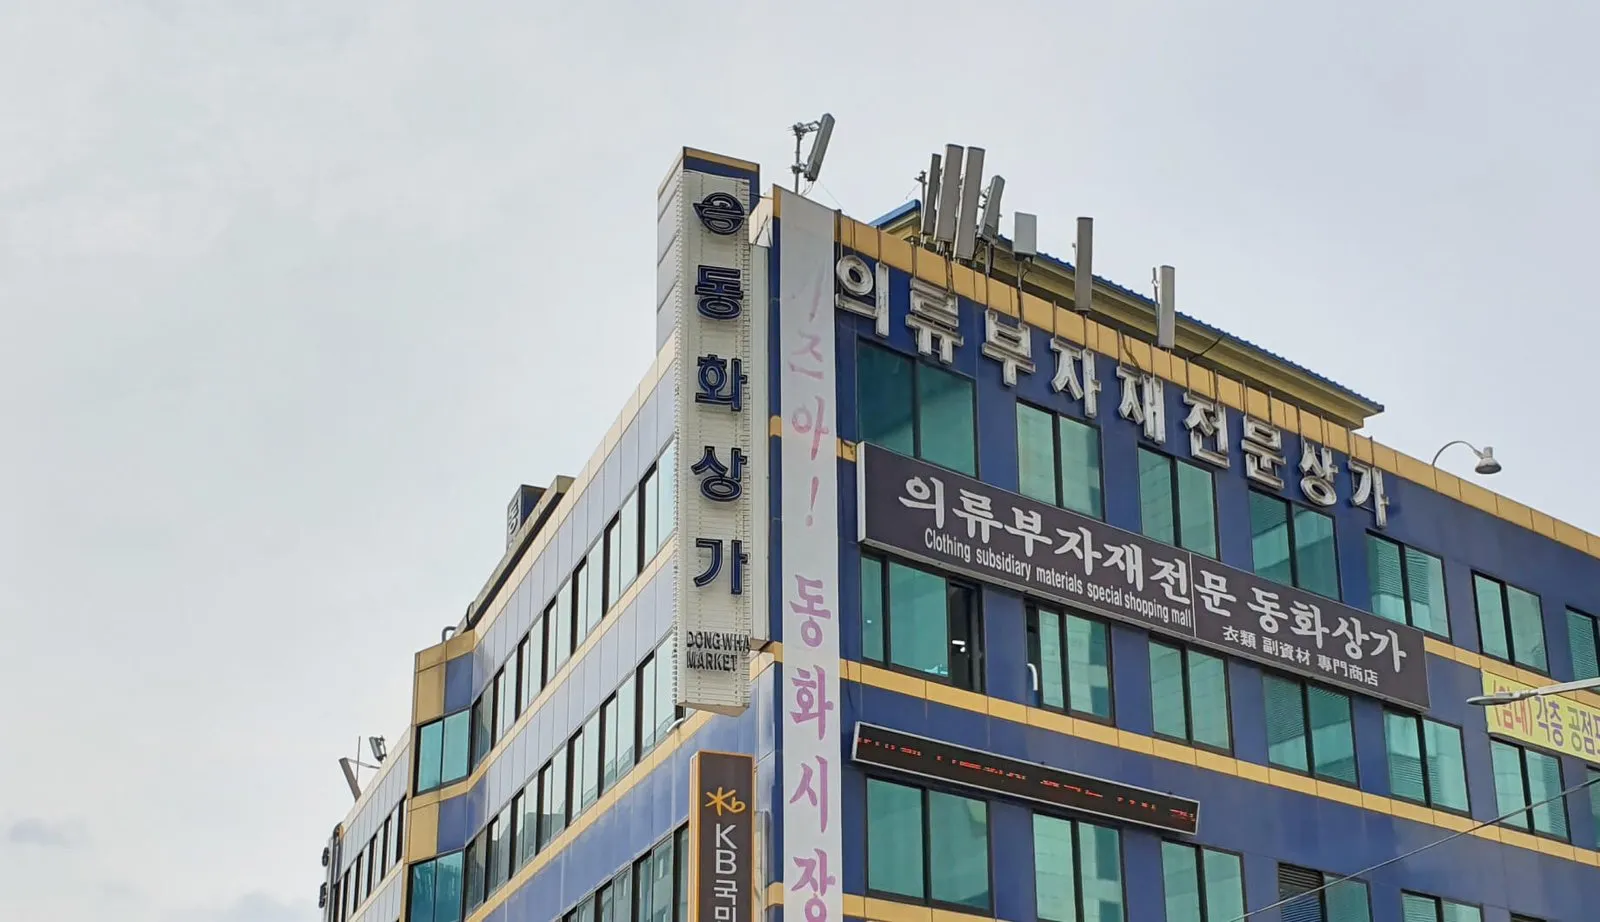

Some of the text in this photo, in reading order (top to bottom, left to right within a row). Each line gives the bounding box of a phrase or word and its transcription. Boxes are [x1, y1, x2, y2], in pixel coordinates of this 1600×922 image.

[691, 264, 748, 595] 동화상가
[835, 254, 1390, 528] 의류부자재전문상가
[686, 631, 750, 655] DONGWHA
[898, 475, 1407, 673] 의류부자재전문 동화상가
[924, 527, 1192, 628] Clothing subsidiary materials special shopping mall
[1222, 625, 1257, 650] 衣類
[686, 650, 738, 672] MARKET
[789, 574, 836, 922] 동화시장
